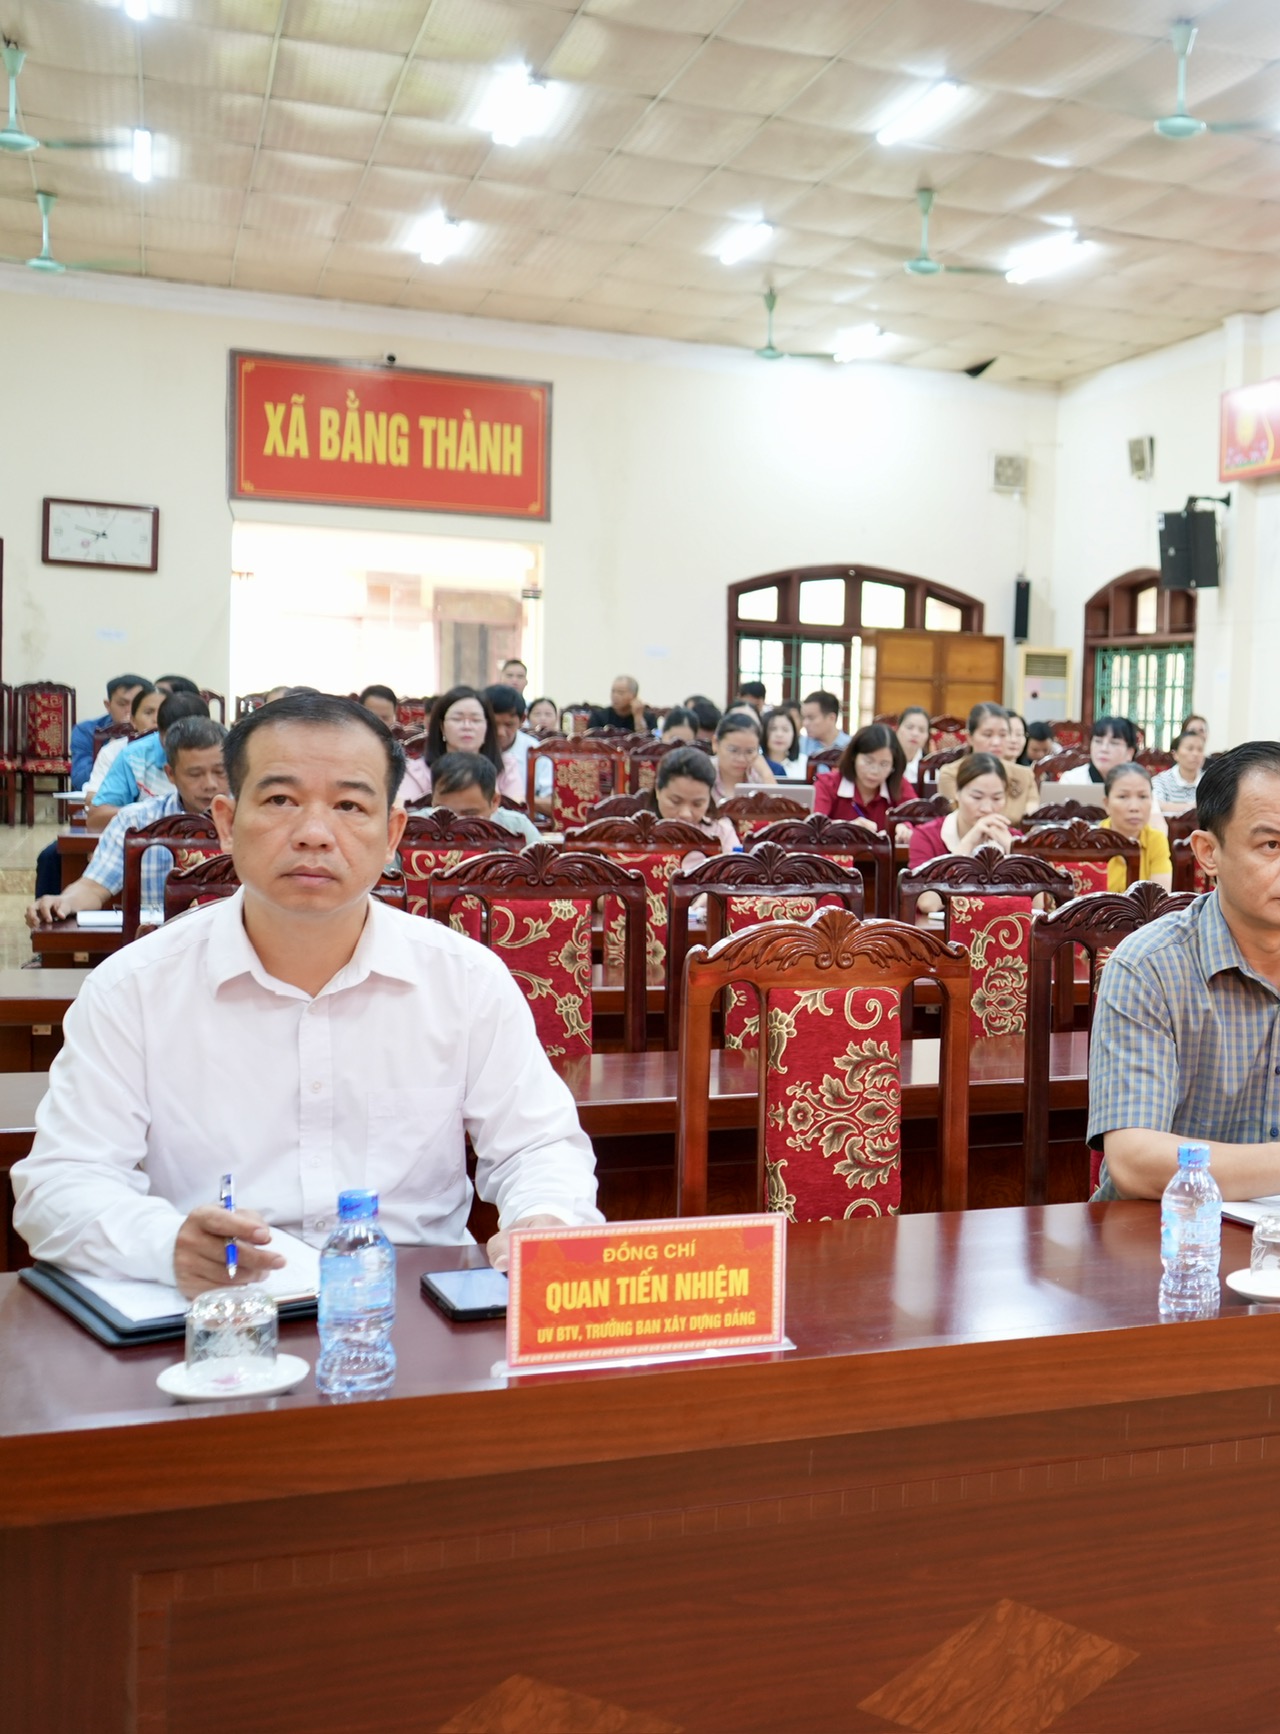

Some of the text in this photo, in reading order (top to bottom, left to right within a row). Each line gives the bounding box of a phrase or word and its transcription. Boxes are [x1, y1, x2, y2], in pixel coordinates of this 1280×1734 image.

[263, 388, 523, 477] XÃ BẰNG THÀNH
[602, 1238, 697, 1263] ĐỒNG CHÍ
[546, 1264, 749, 1314] QUAN TIẾN NHIỆM
[537, 1308, 756, 1344] UV BTV, TRƯỞNG BAN XÂY DỰNG ĐẢNG
